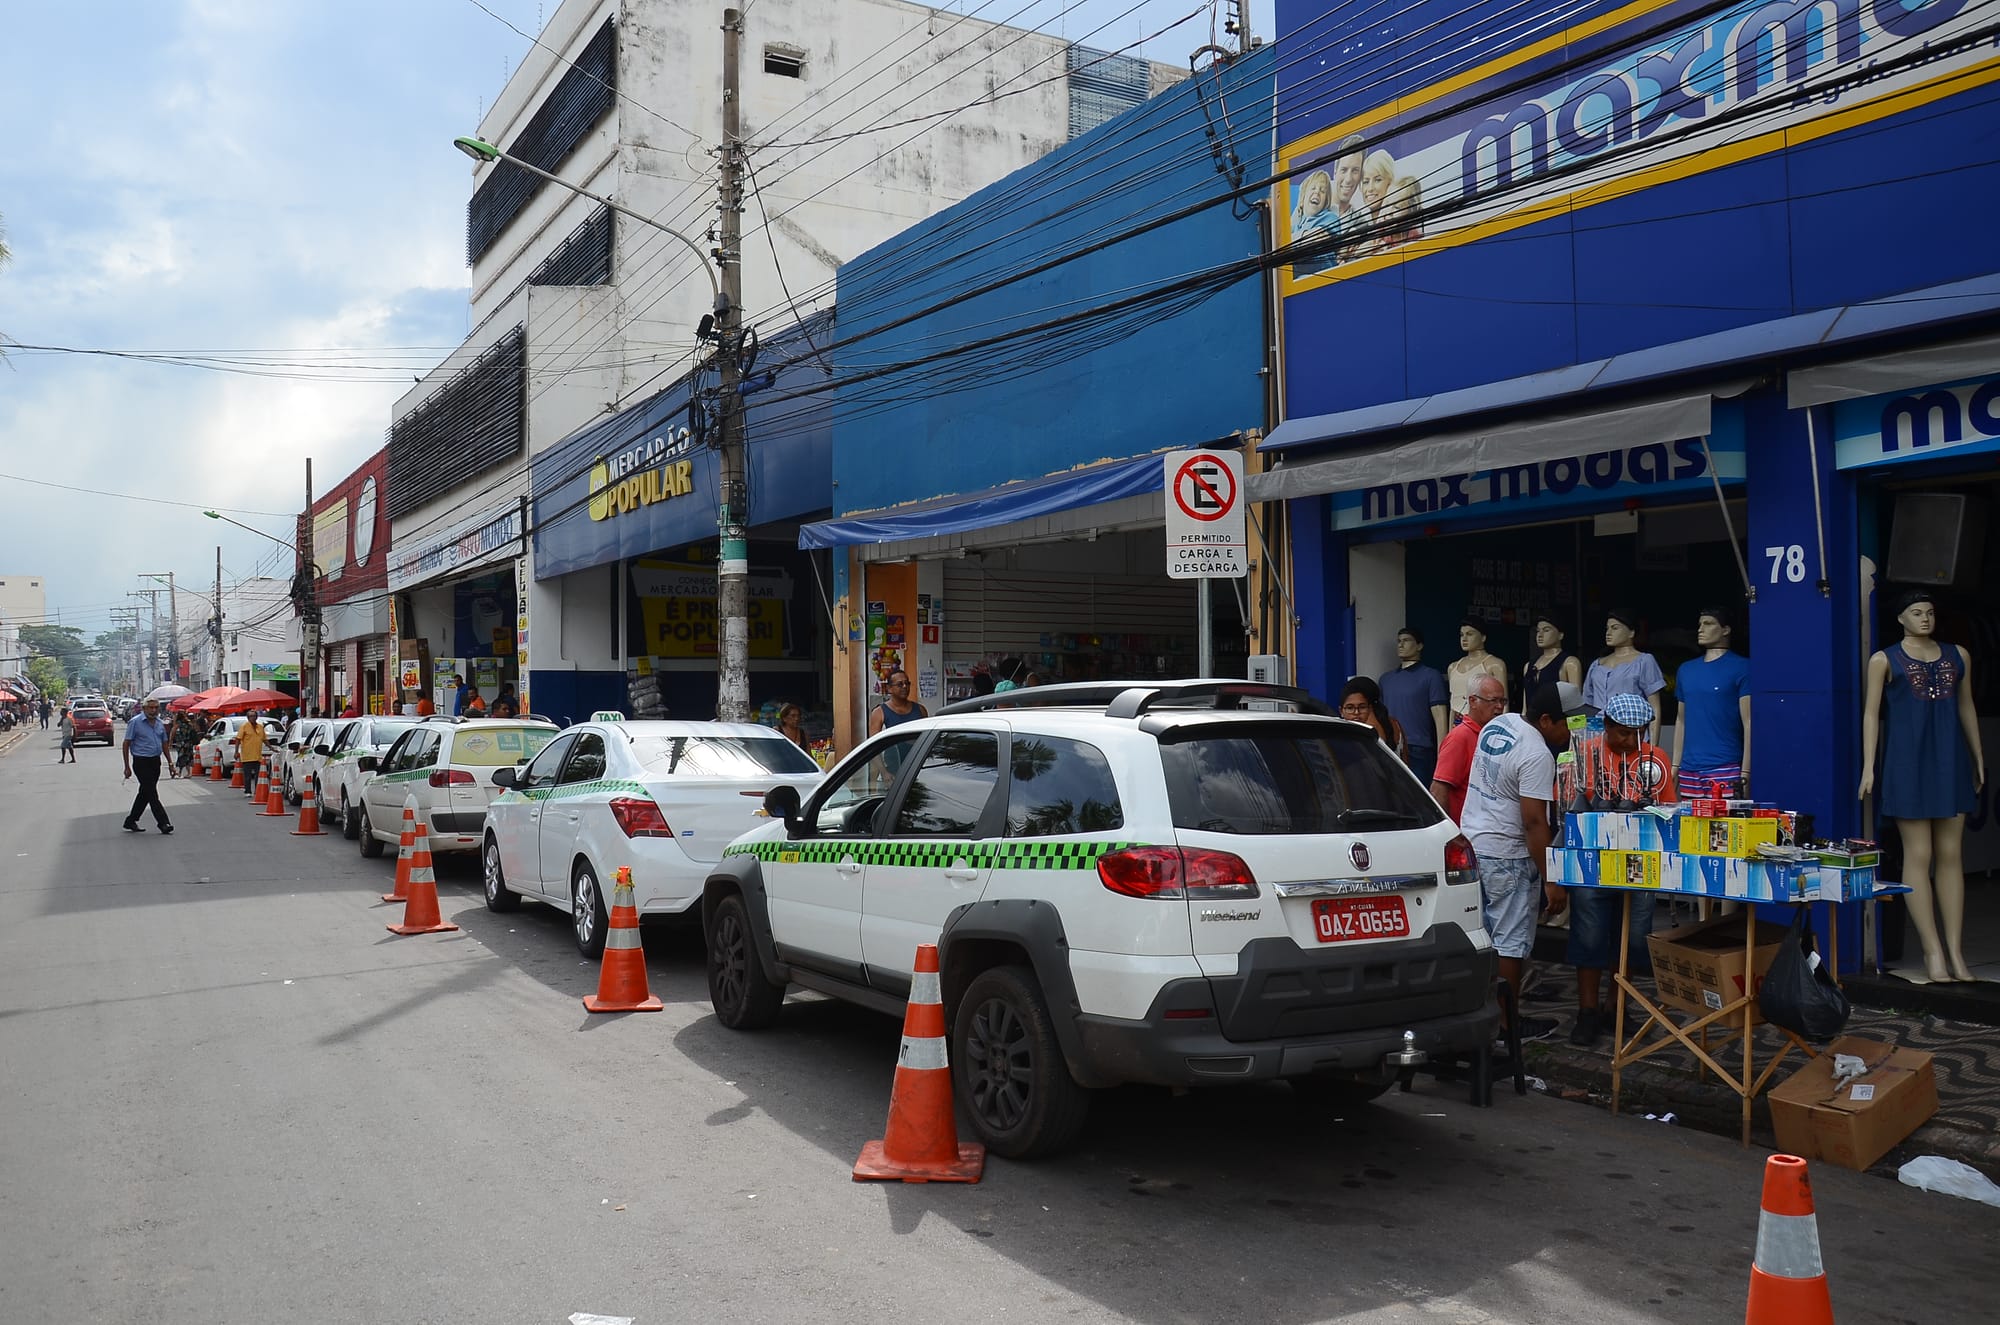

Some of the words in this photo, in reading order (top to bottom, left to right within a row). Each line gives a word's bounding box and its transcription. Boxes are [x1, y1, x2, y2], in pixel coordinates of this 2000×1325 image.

[608, 423, 691, 482] MERCADÃO
[1361, 473, 1469, 521] max
[1489, 436, 1707, 502] modas
[607, 459, 692, 517] POPULAR
[1181, 534, 1232, 543] PERMITIDO
[1179, 549, 1220, 558] CARGA
[1226, 549, 1234, 558] E
[1174, 563, 1239, 573] DESCARGA
[1765, 544, 1806, 584] 78
[666, 597, 681, 620] É
[596, 713, 622, 722] TAXI
[1354, 849, 1368, 863] FIAT
[1200, 908, 1262, 922] Weekend
